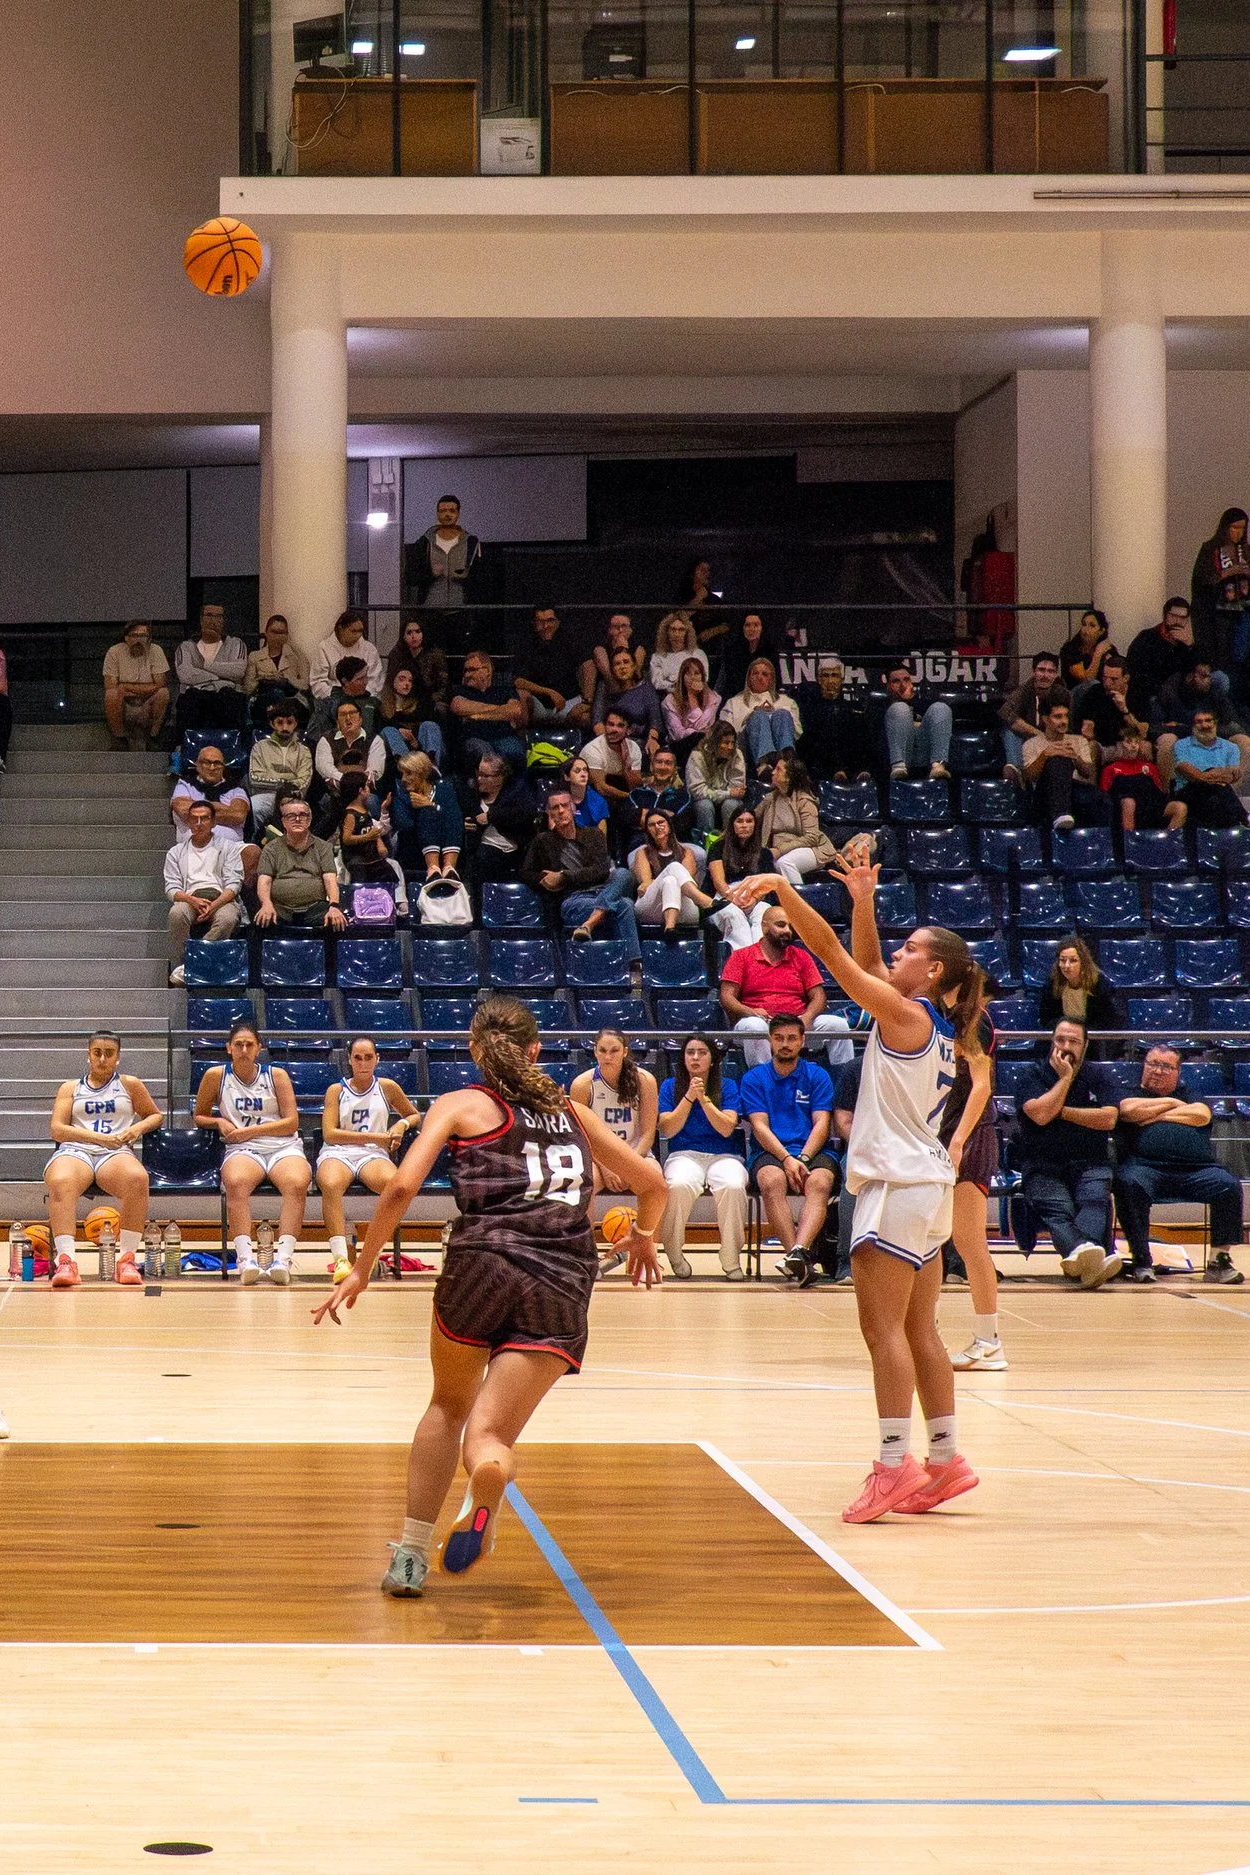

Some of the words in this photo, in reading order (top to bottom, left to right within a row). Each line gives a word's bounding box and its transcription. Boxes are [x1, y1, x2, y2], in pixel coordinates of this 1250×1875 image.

[84, 1099, 116, 1115] CPN
[235, 1097, 263, 1112] CPN
[604, 1106, 633, 1124] CPN
[92, 1119, 113, 1135] 15
[521, 1141, 584, 1206] 18
